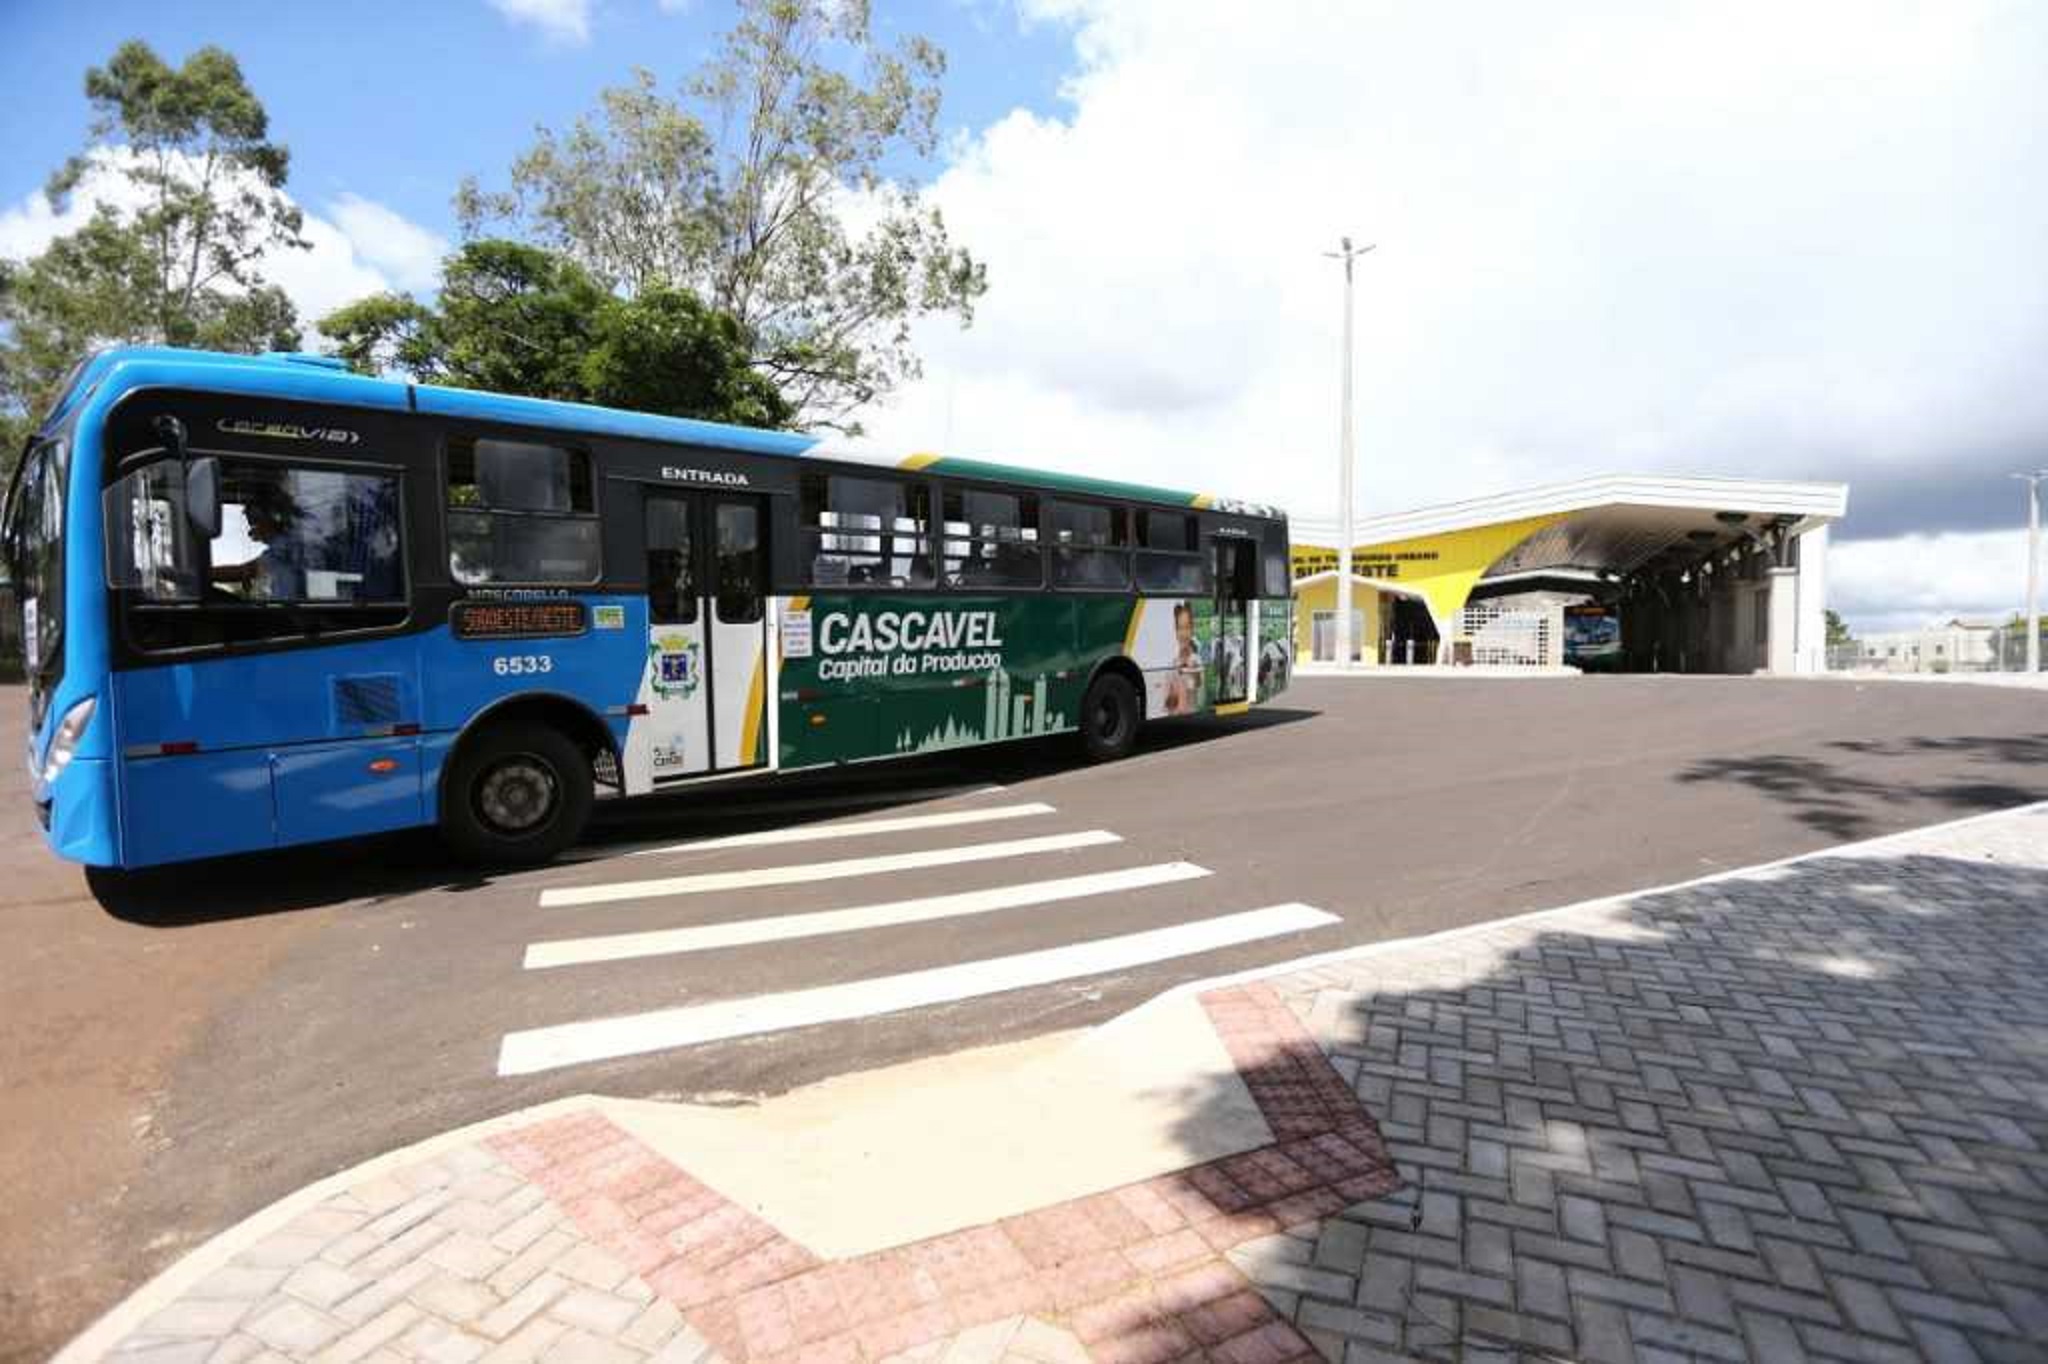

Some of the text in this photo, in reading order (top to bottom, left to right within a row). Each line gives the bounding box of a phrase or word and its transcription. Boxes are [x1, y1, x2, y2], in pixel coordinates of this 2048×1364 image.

[661, 466, 750, 485] ENTRADA
[819, 611, 1003, 654] CASCAVEL
[493, 655, 552, 675] 6533
[818, 655, 889, 682] Capital
[892, 653, 917, 674] da
